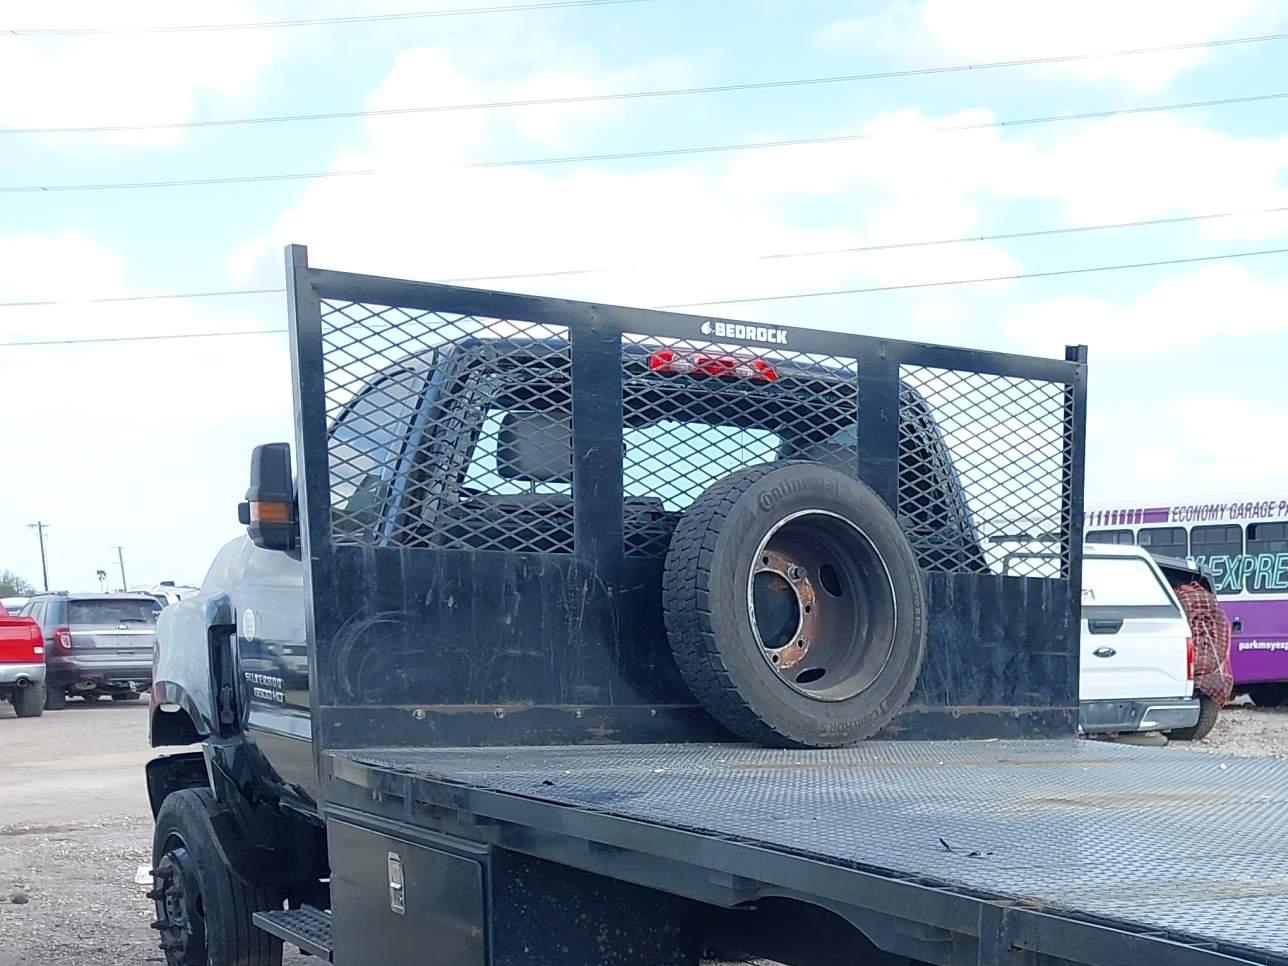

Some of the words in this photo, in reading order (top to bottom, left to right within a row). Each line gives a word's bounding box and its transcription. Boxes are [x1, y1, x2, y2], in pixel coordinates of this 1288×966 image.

[715, 322, 788, 345] BEDROCK
[756, 475, 841, 512] Continental
[1172, 504, 1229, 522] ECONOMY
[1229, 501, 1277, 520] GARAGE
